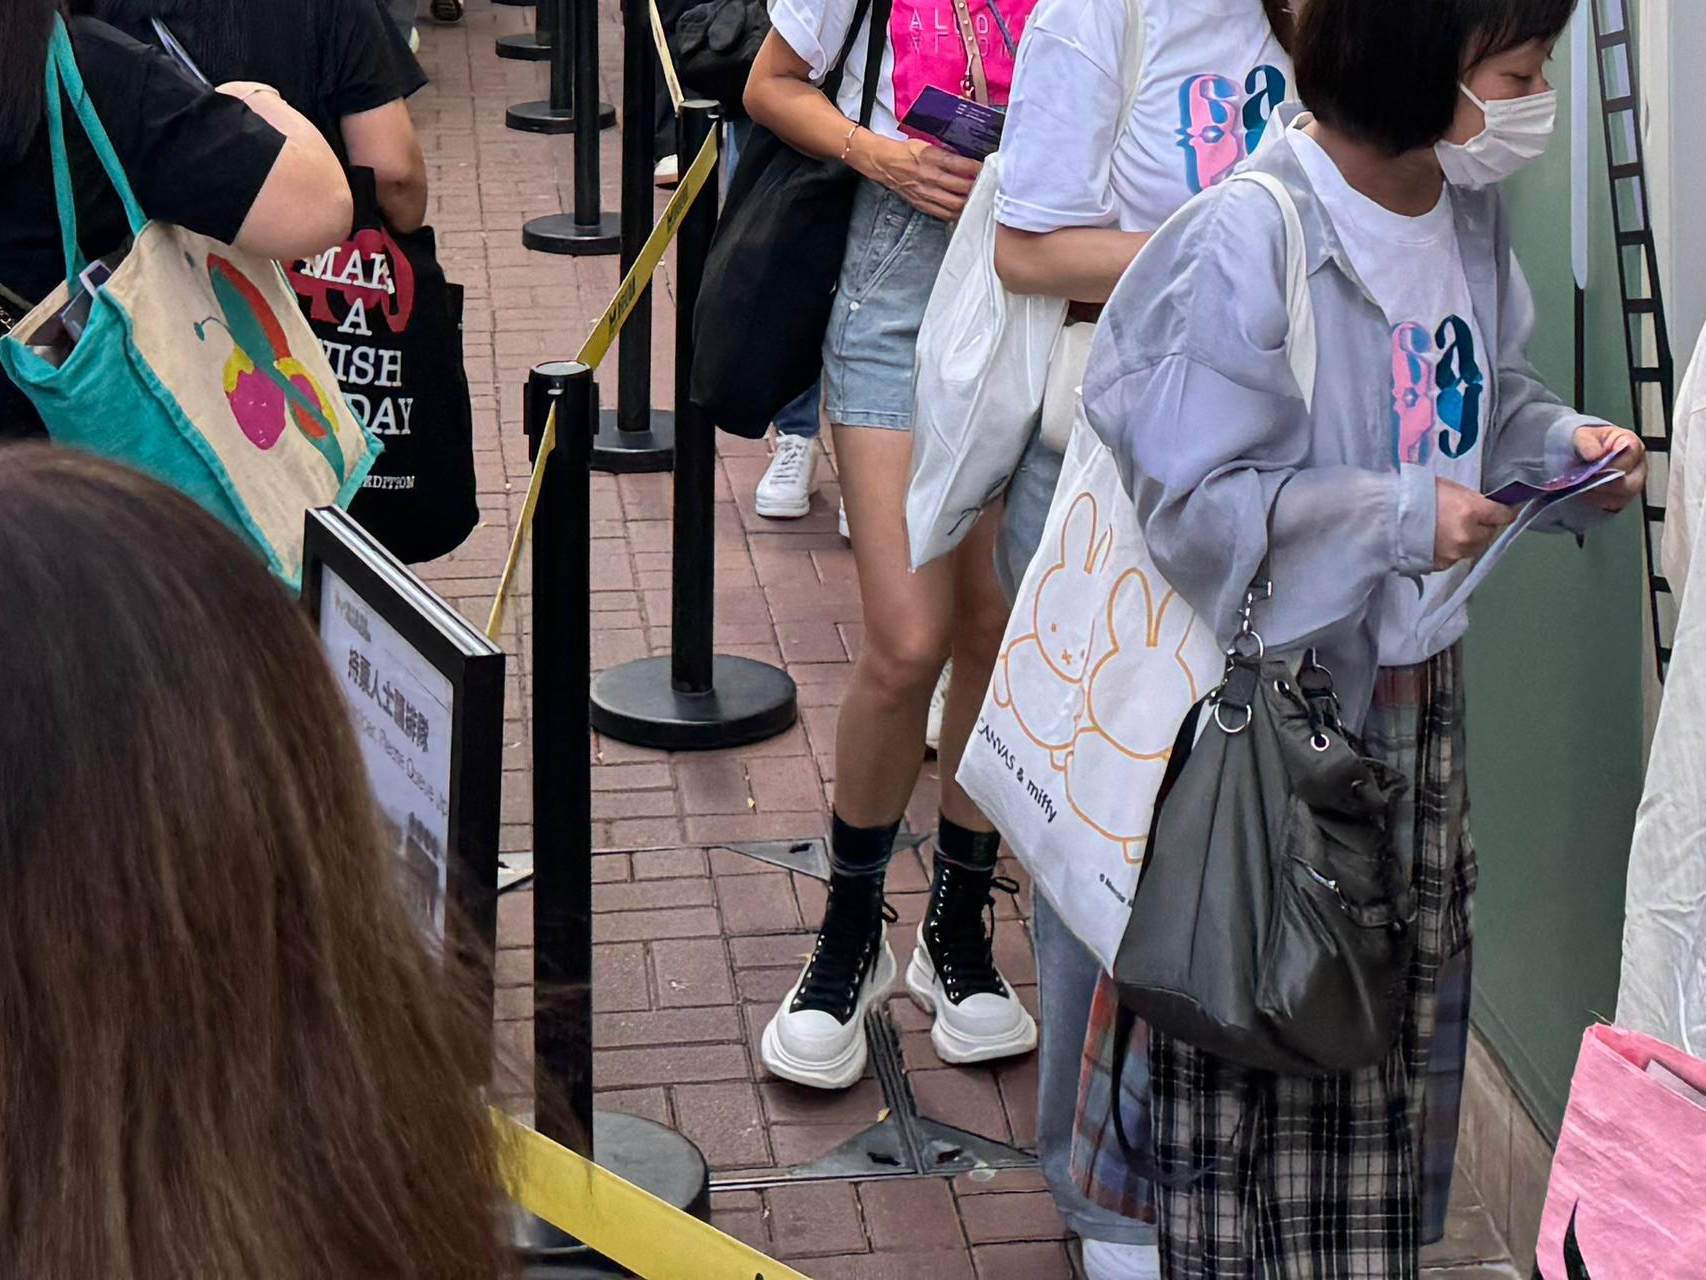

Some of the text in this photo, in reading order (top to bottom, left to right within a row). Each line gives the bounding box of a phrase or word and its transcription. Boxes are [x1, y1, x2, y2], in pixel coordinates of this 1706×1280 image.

[337, 297, 373, 337] A
[316, 338, 403, 388] ISH
[1026, 779, 1058, 824] miffy
